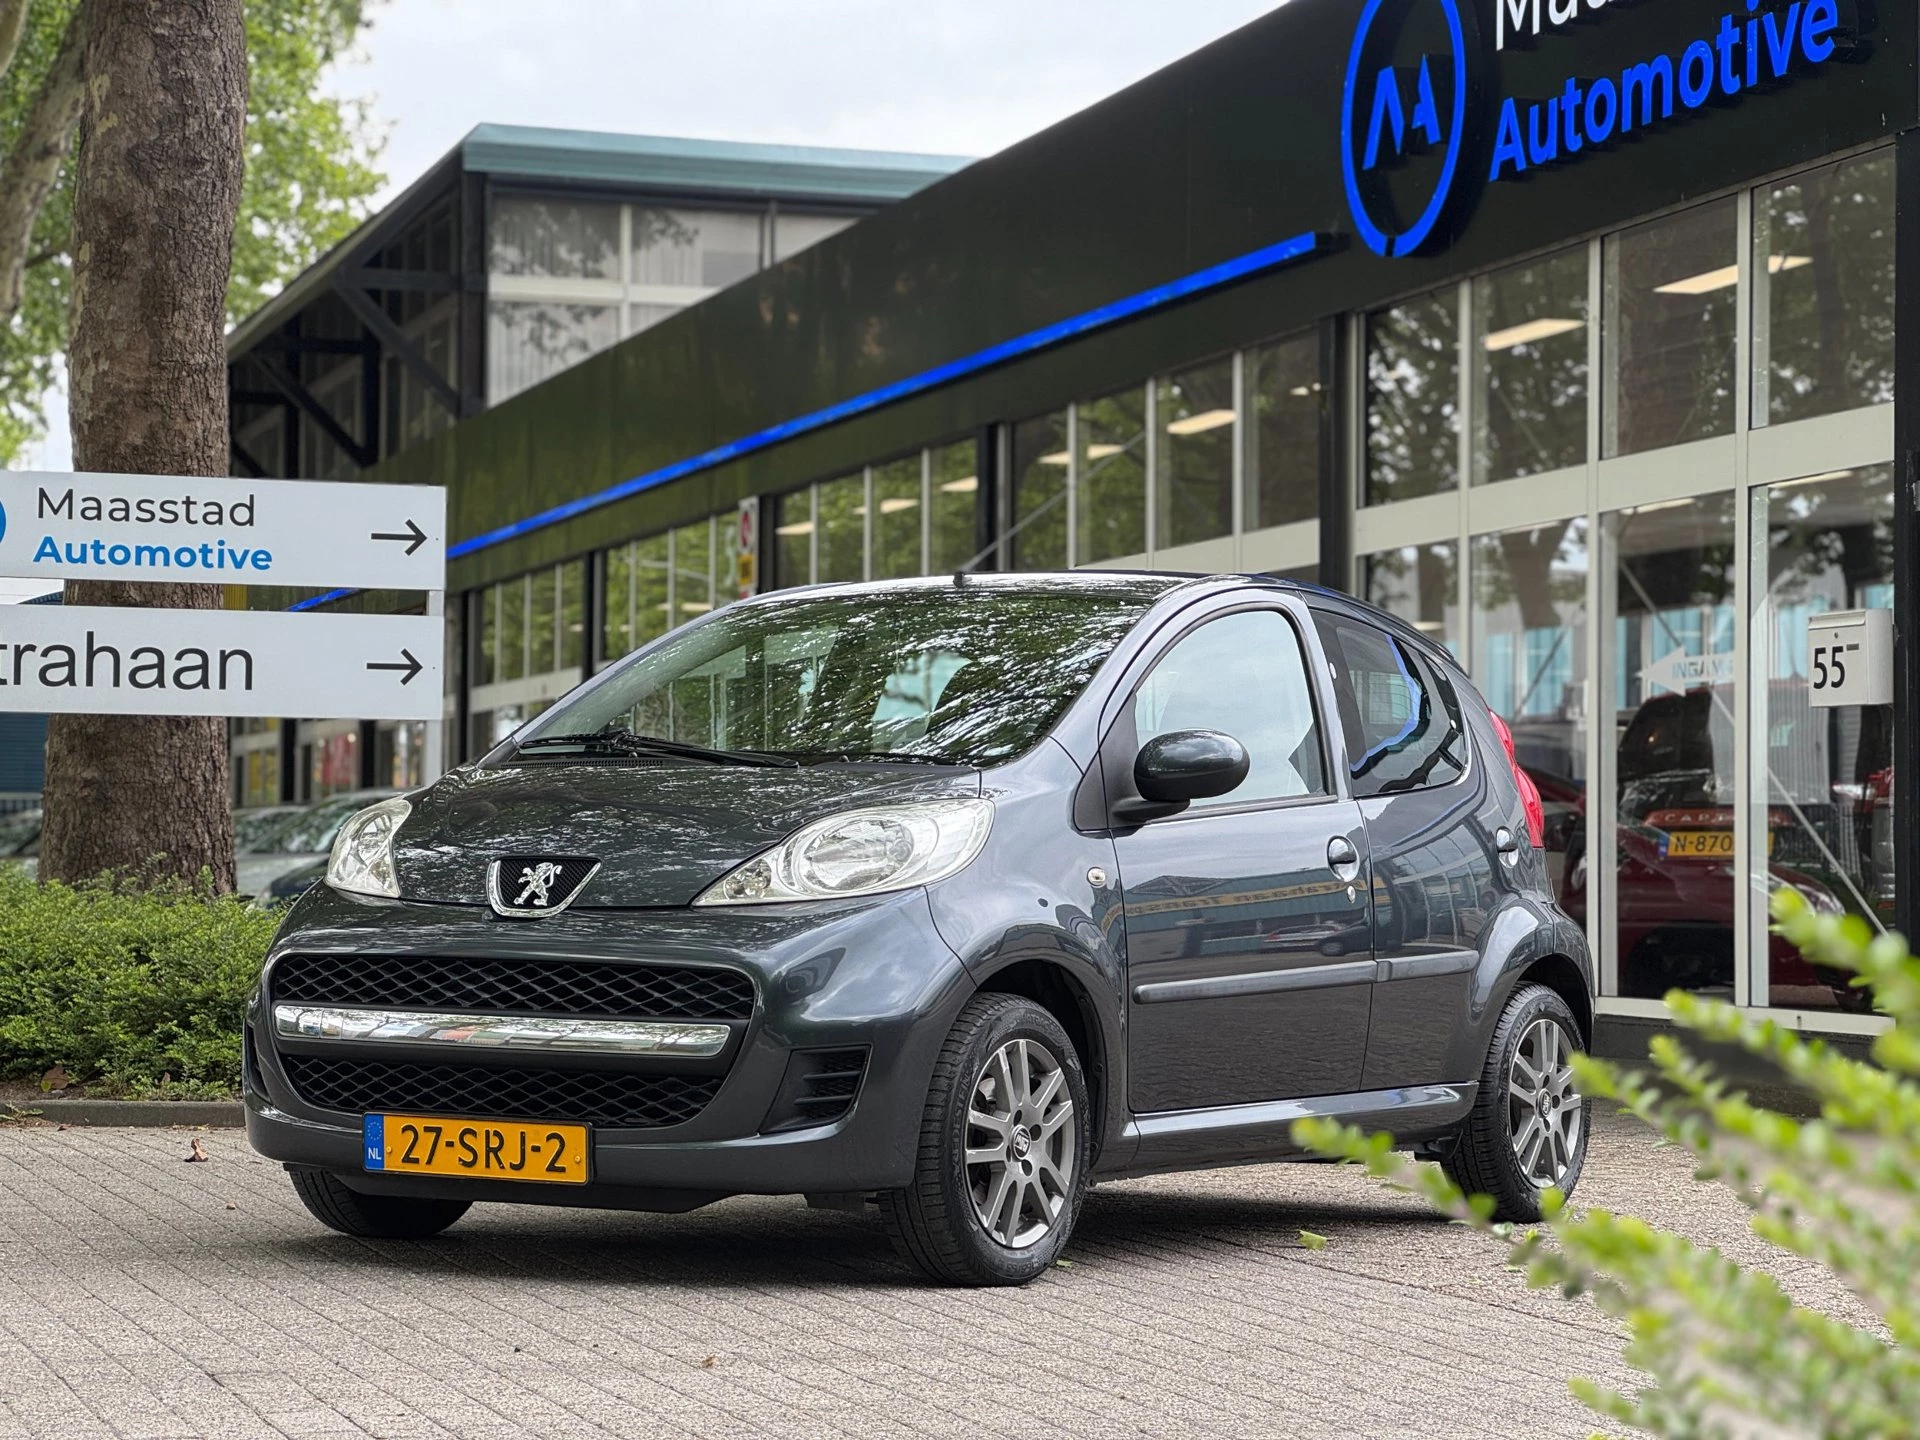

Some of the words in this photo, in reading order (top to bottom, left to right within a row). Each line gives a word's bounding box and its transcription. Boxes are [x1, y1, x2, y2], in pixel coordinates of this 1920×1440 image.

[1489, 0, 1839, 182] Automotive
[37, 487, 255, 527] Maasstad
[33, 536, 273, 571] Automotive
[1813, 645, 1846, 689] 55
[368, 1147, 382, 1160] NL
[400, 1124, 567, 1173] 27-SRJ-2
